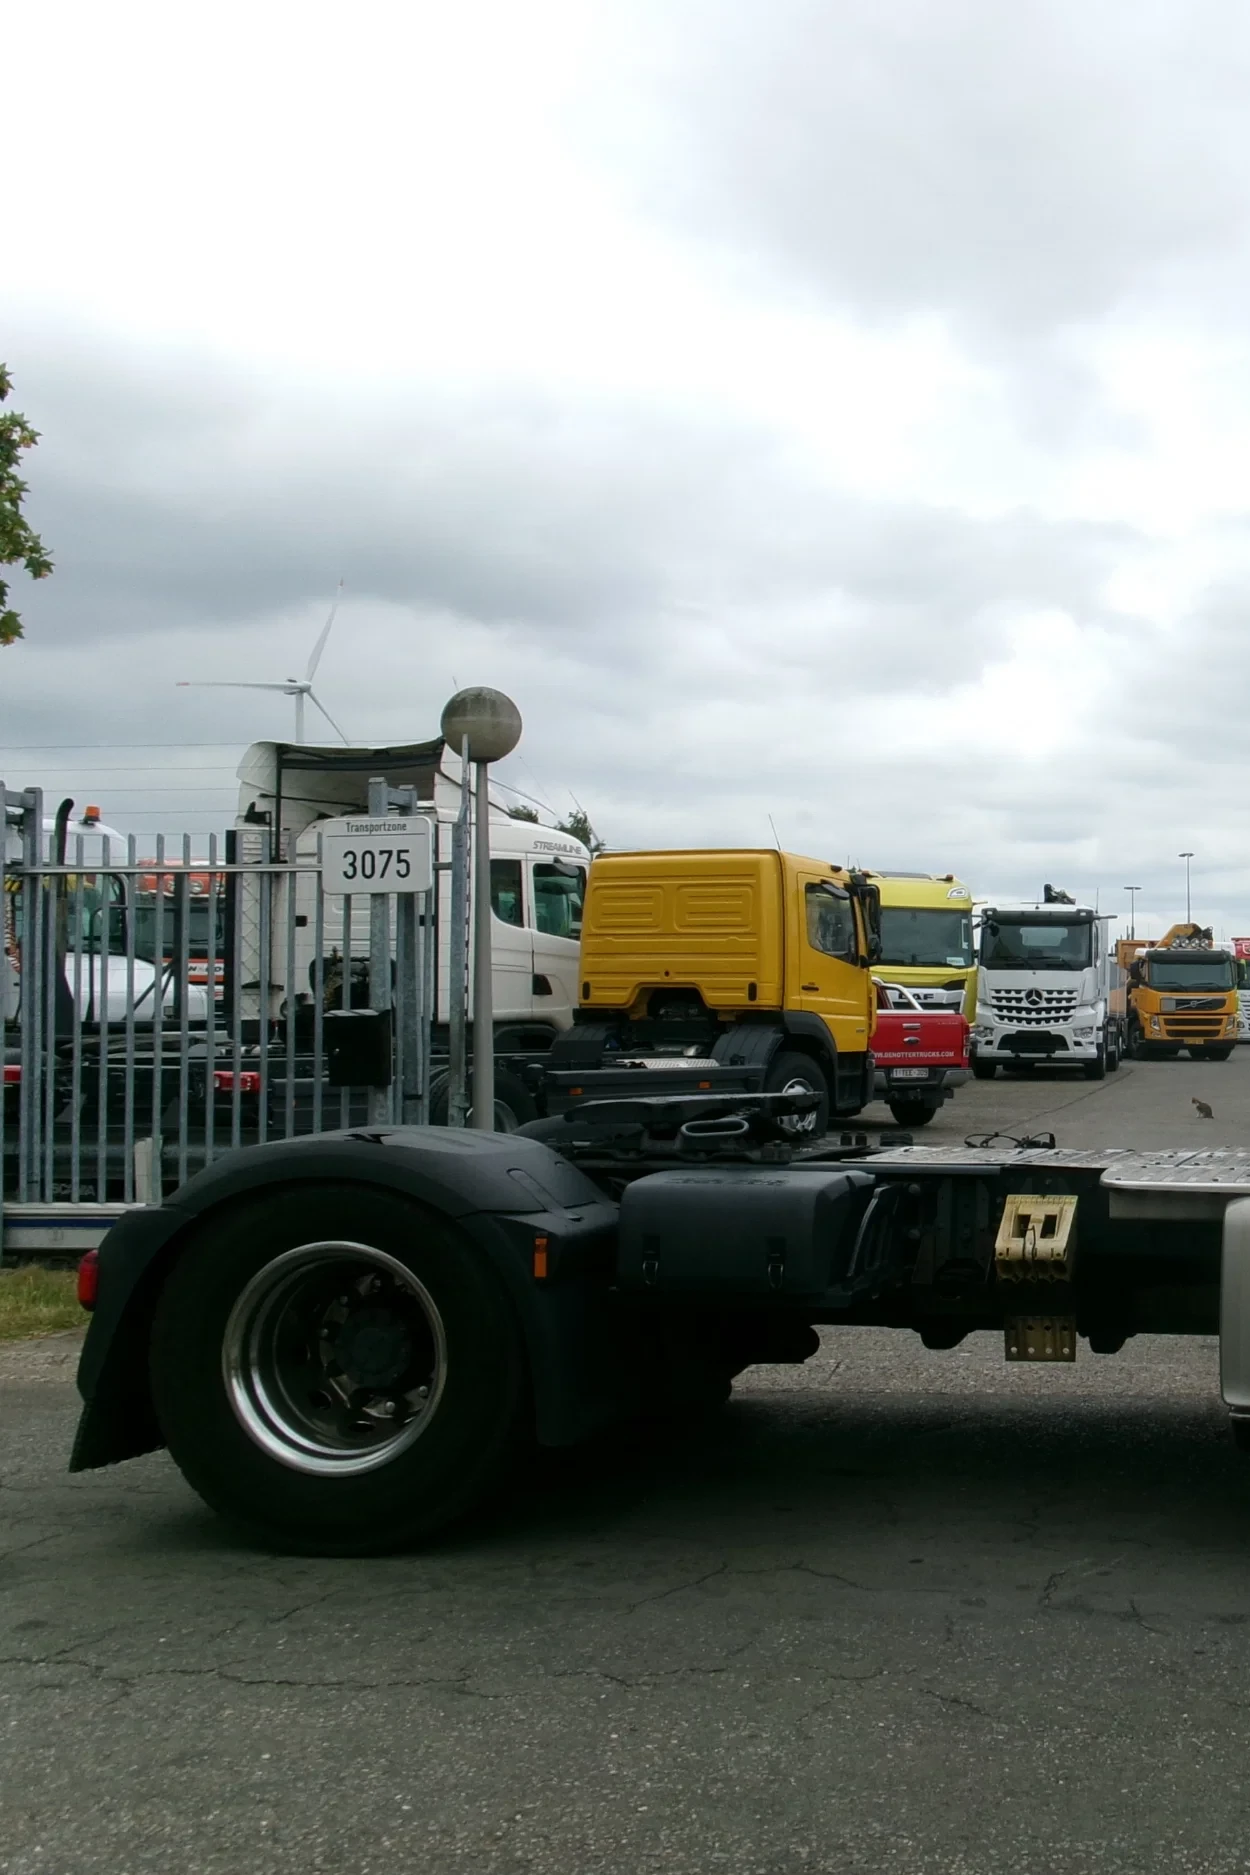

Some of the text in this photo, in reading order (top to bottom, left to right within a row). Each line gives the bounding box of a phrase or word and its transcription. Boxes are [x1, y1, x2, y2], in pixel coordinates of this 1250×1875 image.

[346, 821, 407, 835] Transportzone
[532, 840, 582, 855] STREAMLINE
[342, 849, 411, 880] 3075
